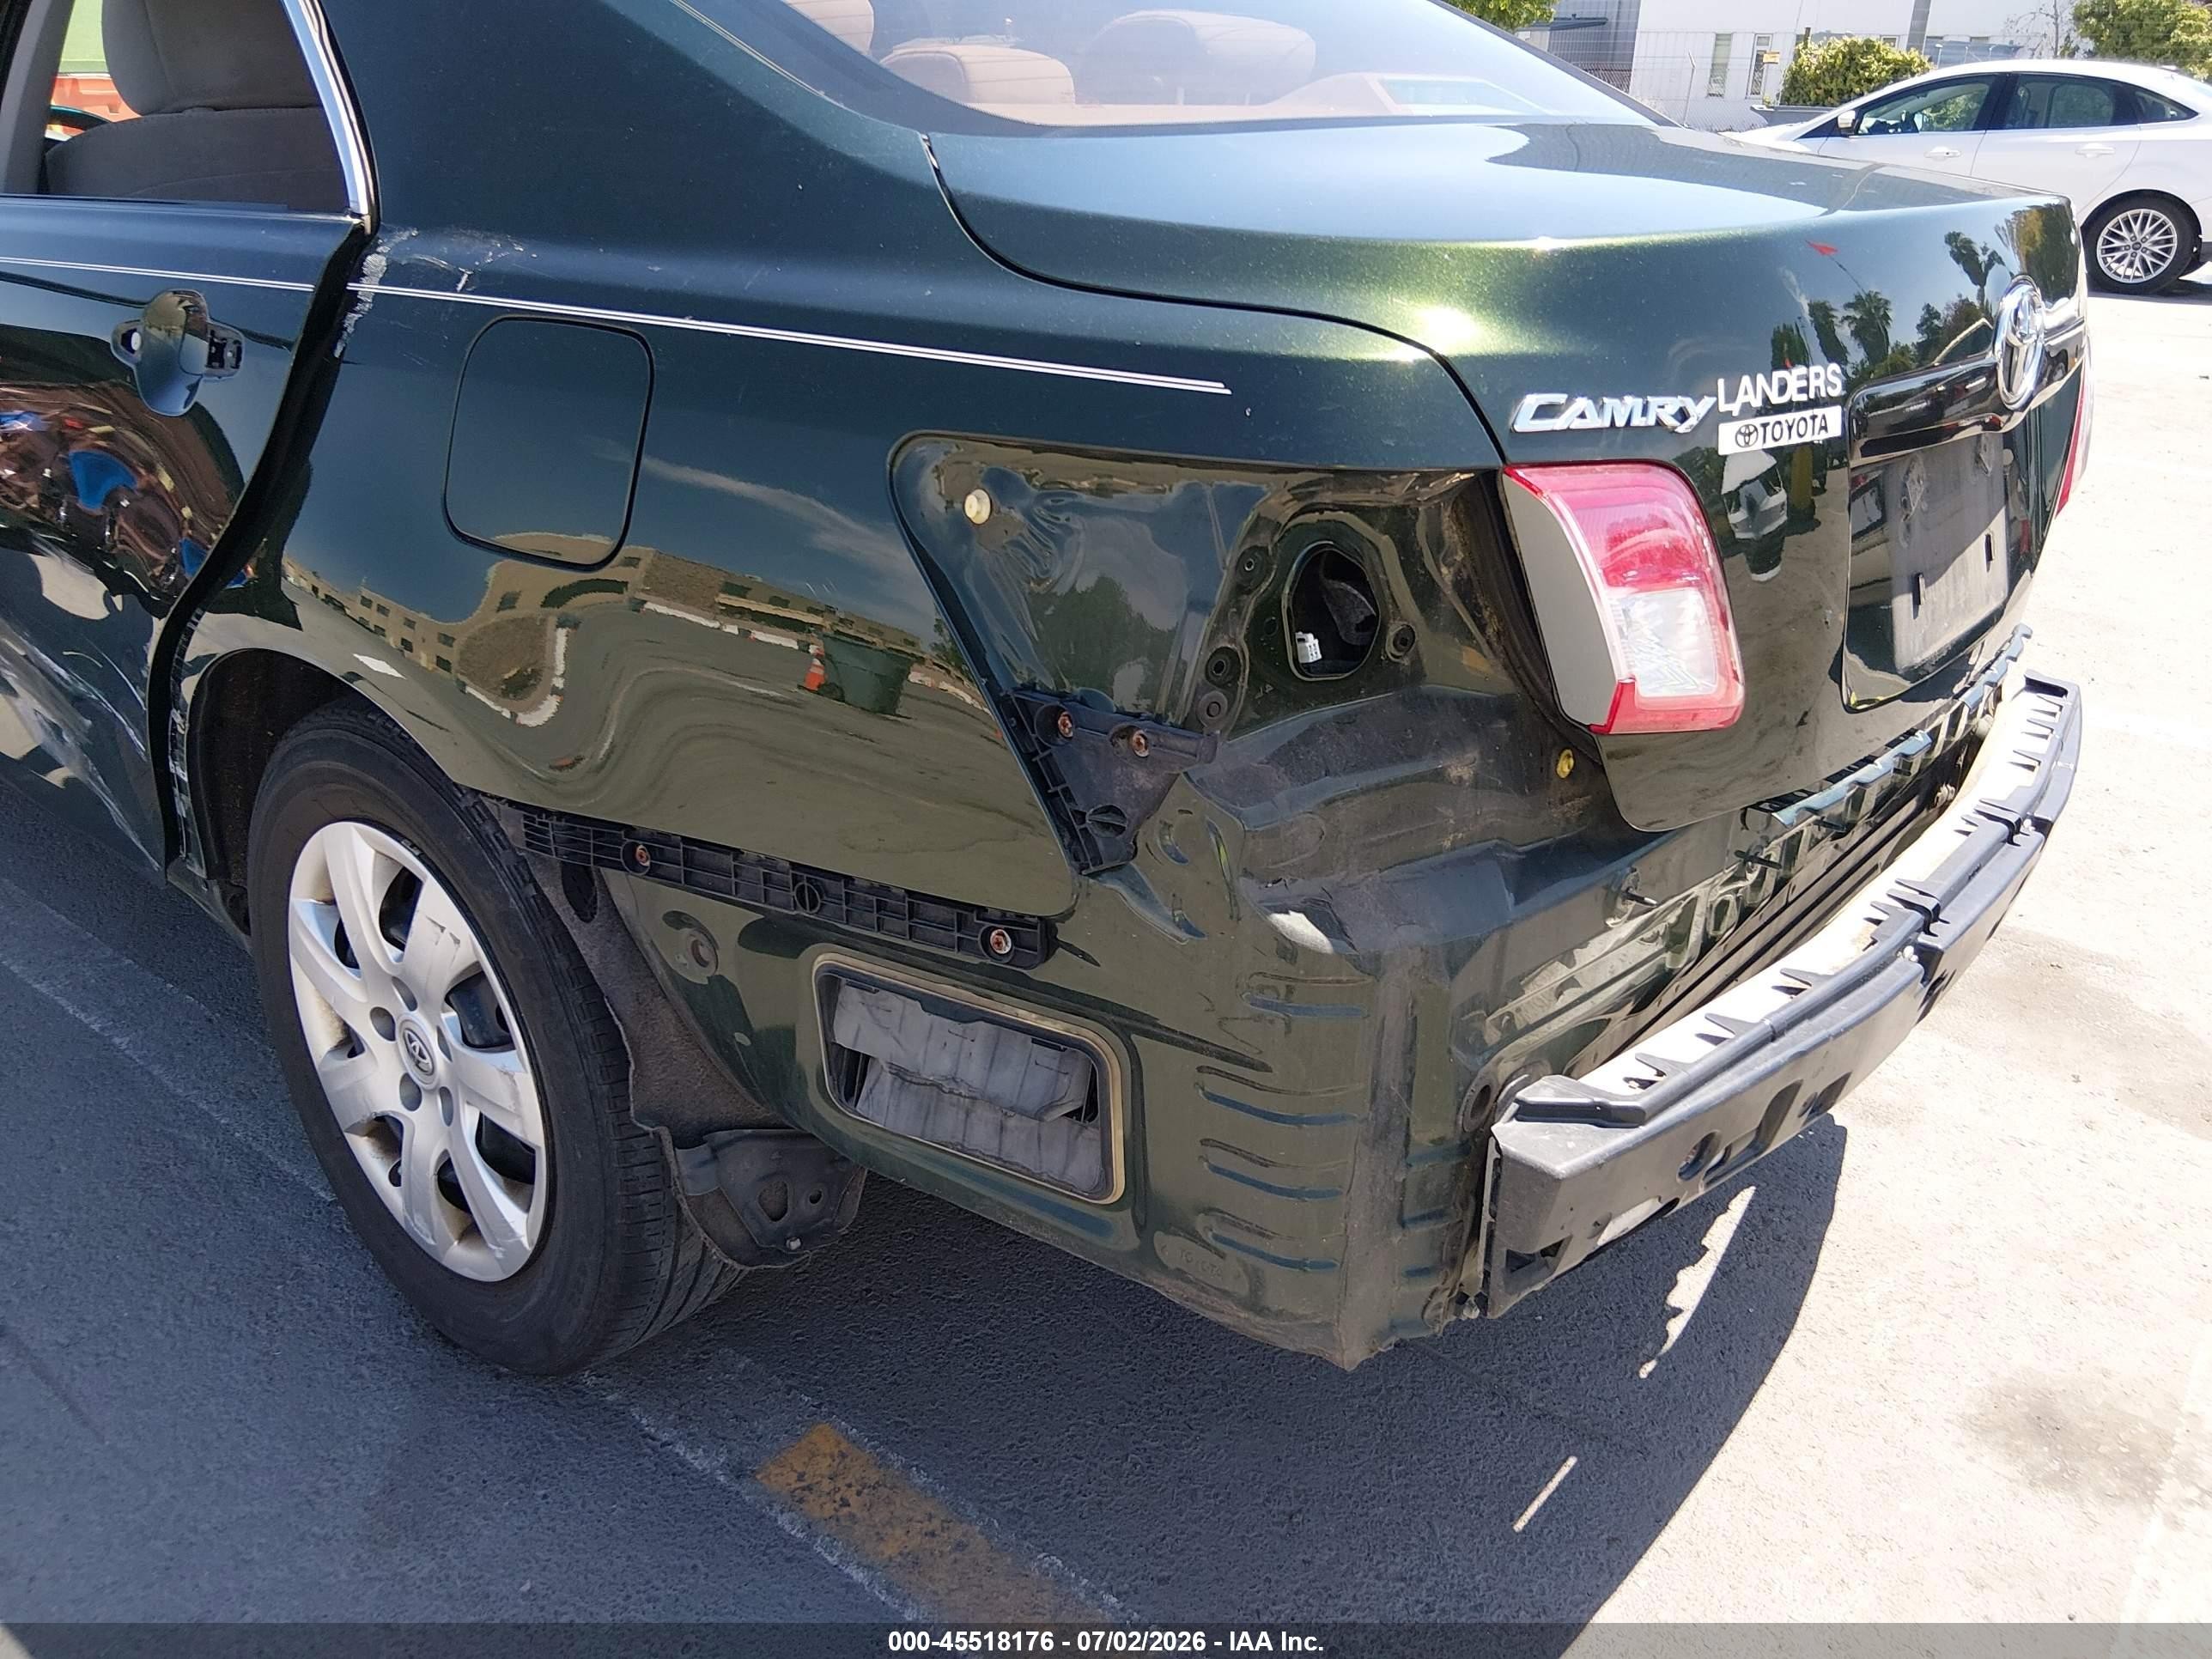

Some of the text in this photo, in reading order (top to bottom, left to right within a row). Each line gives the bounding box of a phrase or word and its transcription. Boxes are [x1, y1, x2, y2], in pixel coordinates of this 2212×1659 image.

[1717, 362, 1843, 416] LANDERS
[1510, 392, 1717, 434] CAMRY
[1759, 418, 1829, 445] TOYOTA
